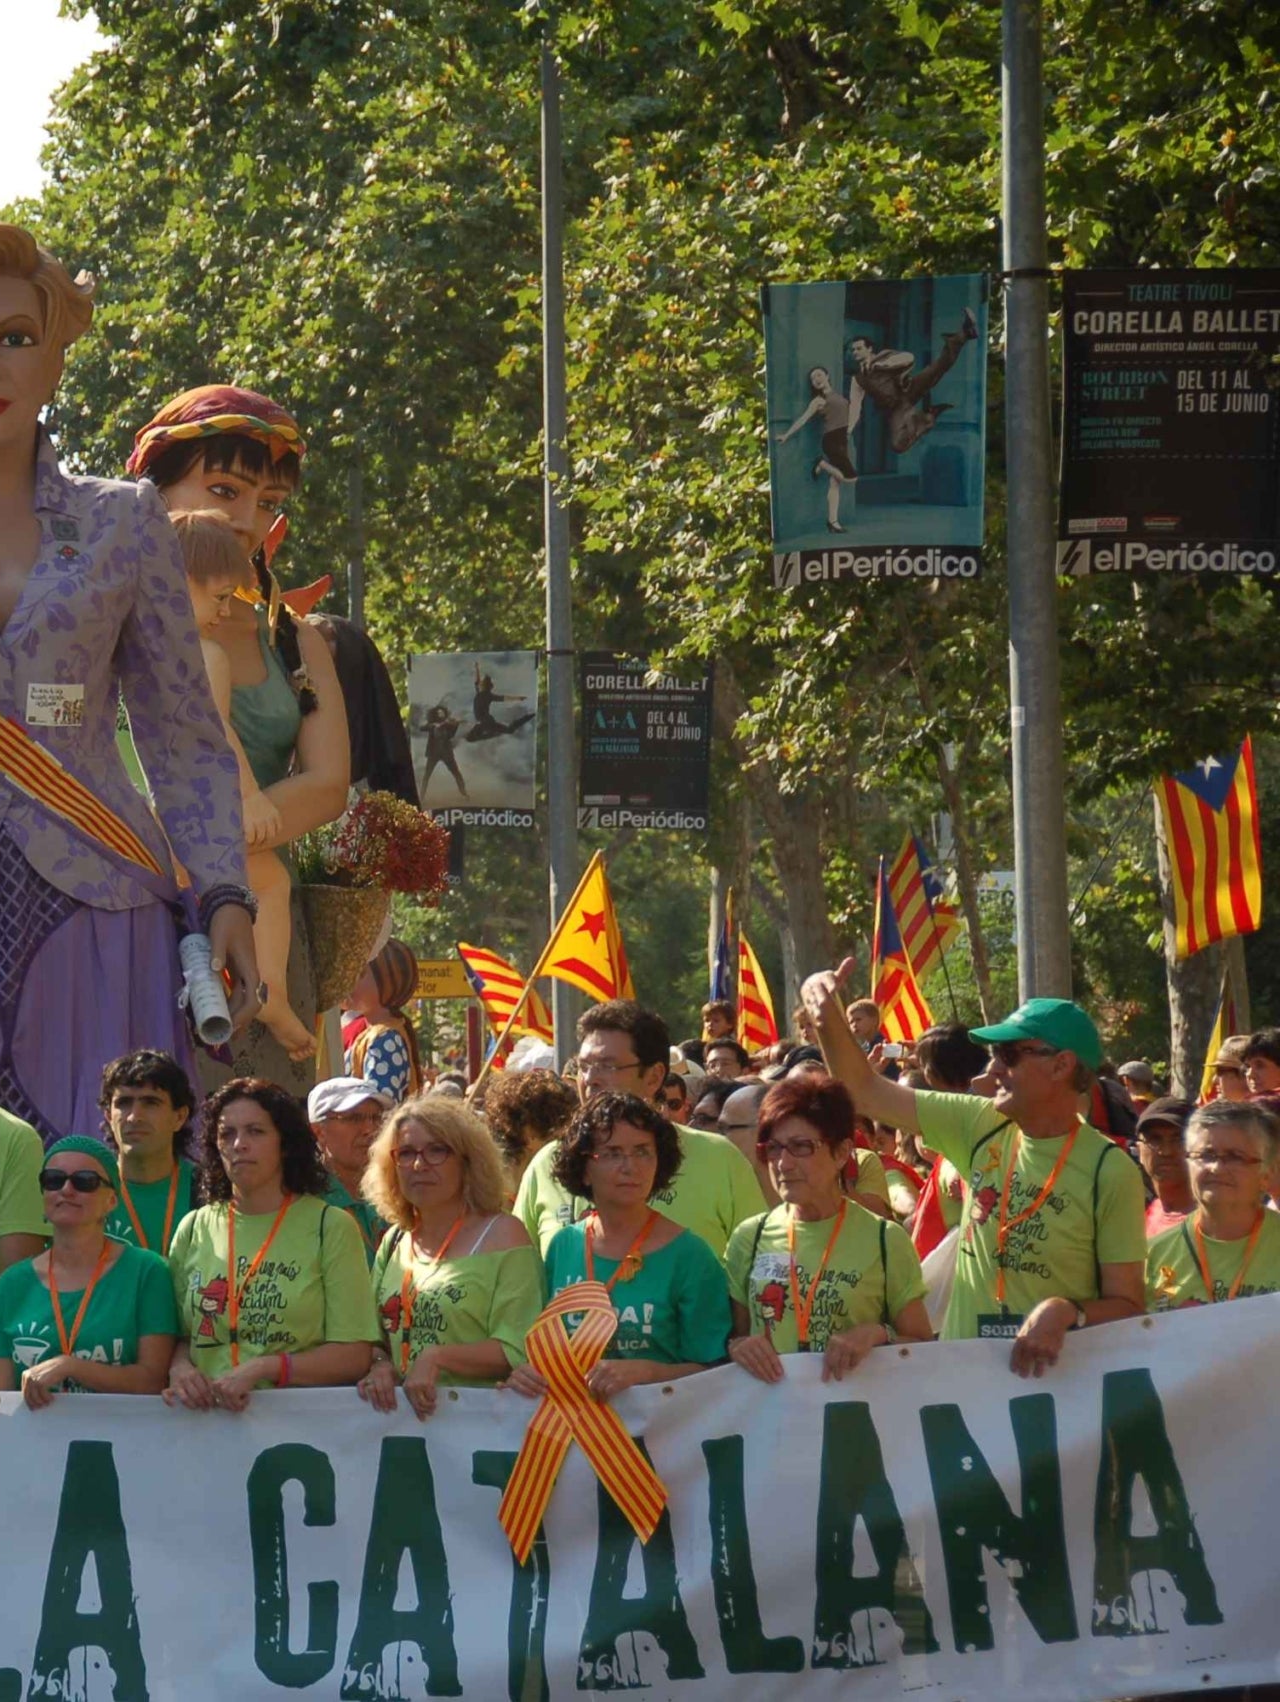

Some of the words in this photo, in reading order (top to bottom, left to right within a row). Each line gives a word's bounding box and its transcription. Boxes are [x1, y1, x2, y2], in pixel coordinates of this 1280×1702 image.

[1073, 311, 1183, 335] CORELLA
[1193, 309, 1280, 333] BALLET
[1177, 370, 1204, 390] DEL
[1211, 370, 1227, 389] 11
[1233, 370, 1252, 389] AL
[1177, 393, 1195, 413] 15
[1199, 392, 1218, 412] DE
[1222, 392, 1269, 412] JUNIO
[647, 711, 664, 725] DEL
[677, 711, 689, 725] AL
[656, 726, 669, 739] DE
[671, 727, 702, 741] JUNIO
[247, 1367, 1225, 1702] CATALANA
